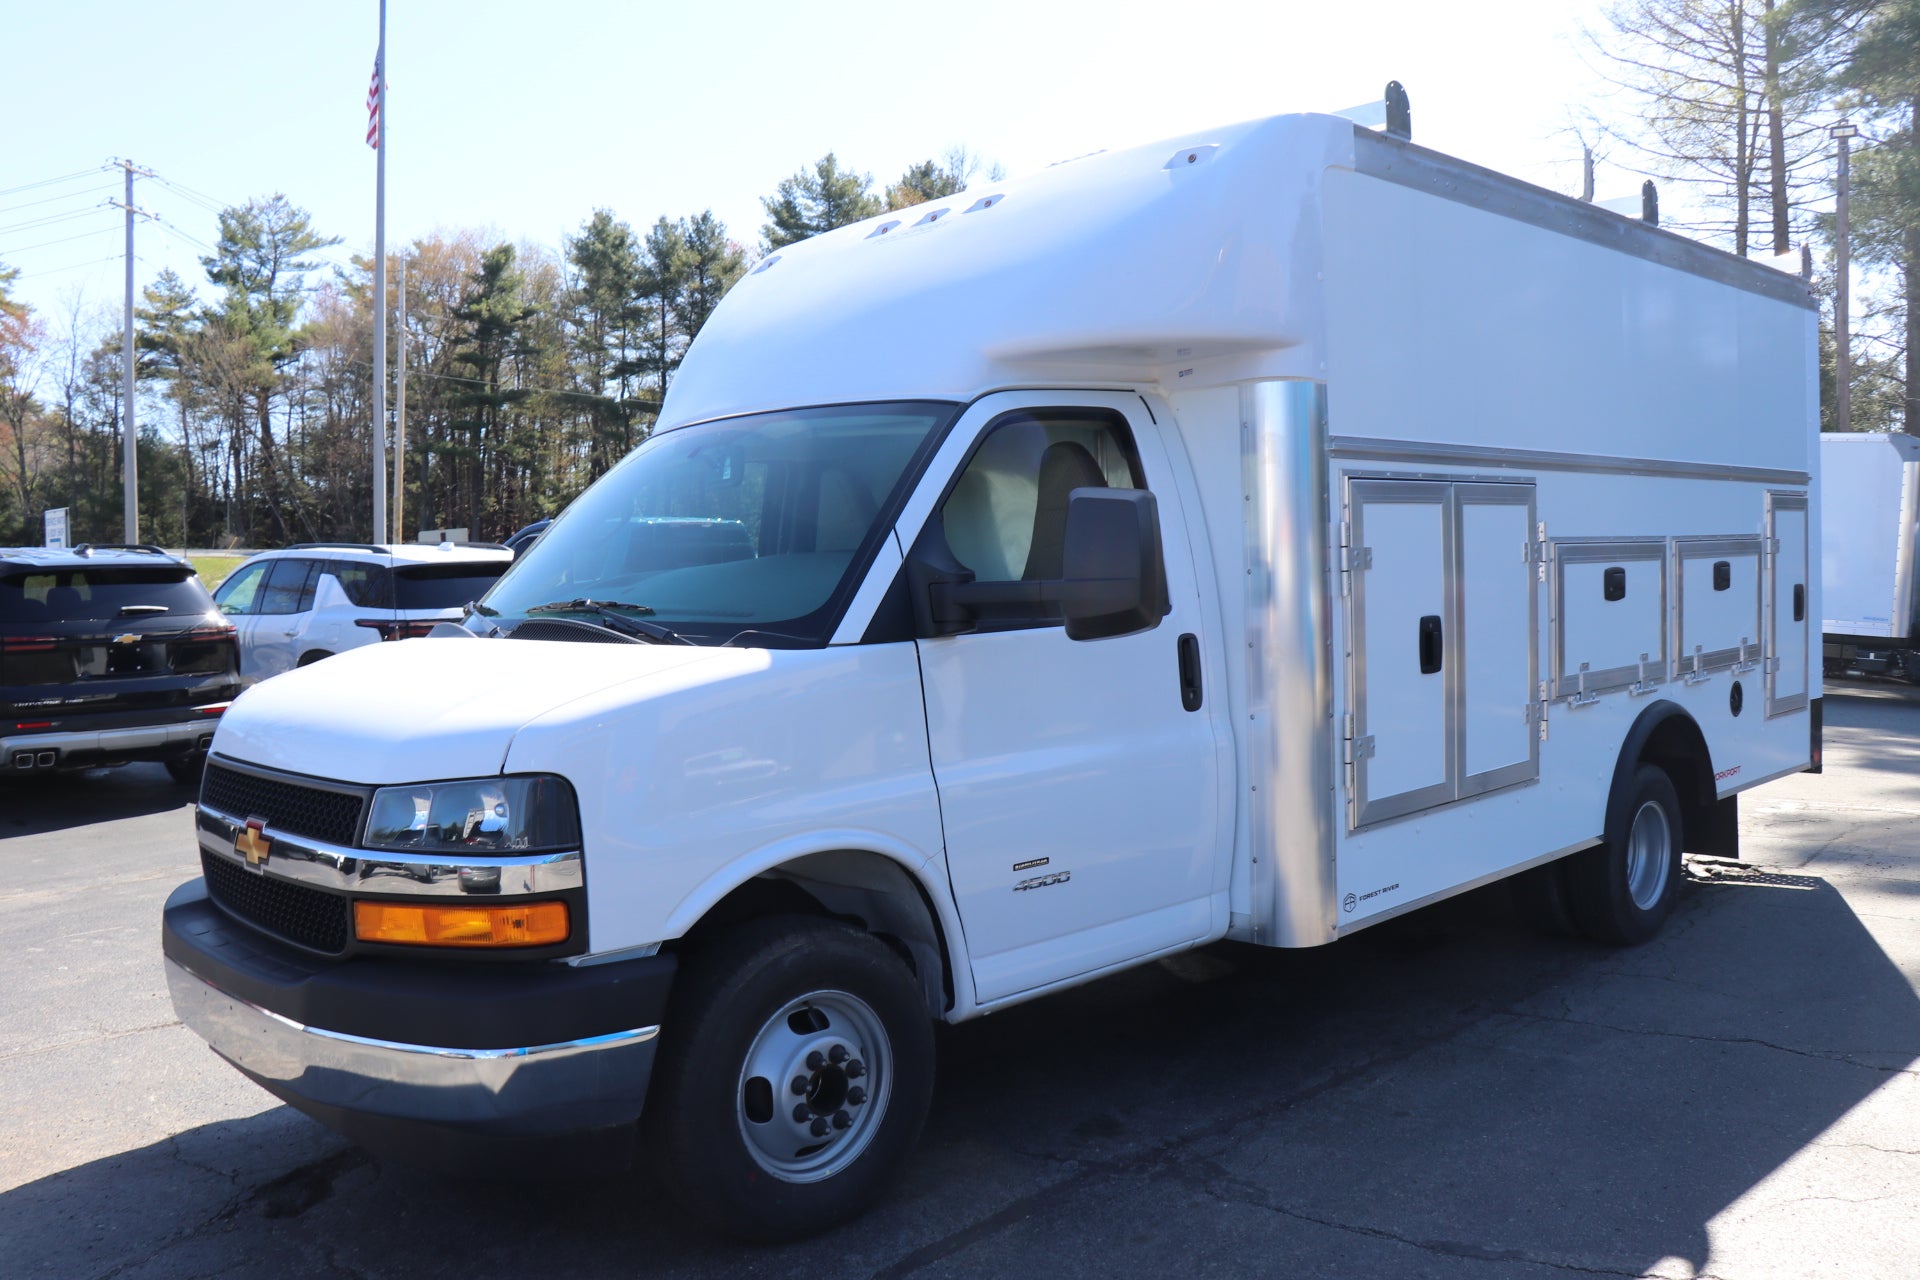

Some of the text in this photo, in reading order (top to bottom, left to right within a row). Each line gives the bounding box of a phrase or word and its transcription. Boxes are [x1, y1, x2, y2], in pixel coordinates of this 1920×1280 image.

[1715, 765, 1741, 781] ORKPORT
[1012, 870, 1070, 891] 4500
[1359, 883, 1399, 901] FOREST RIVER
